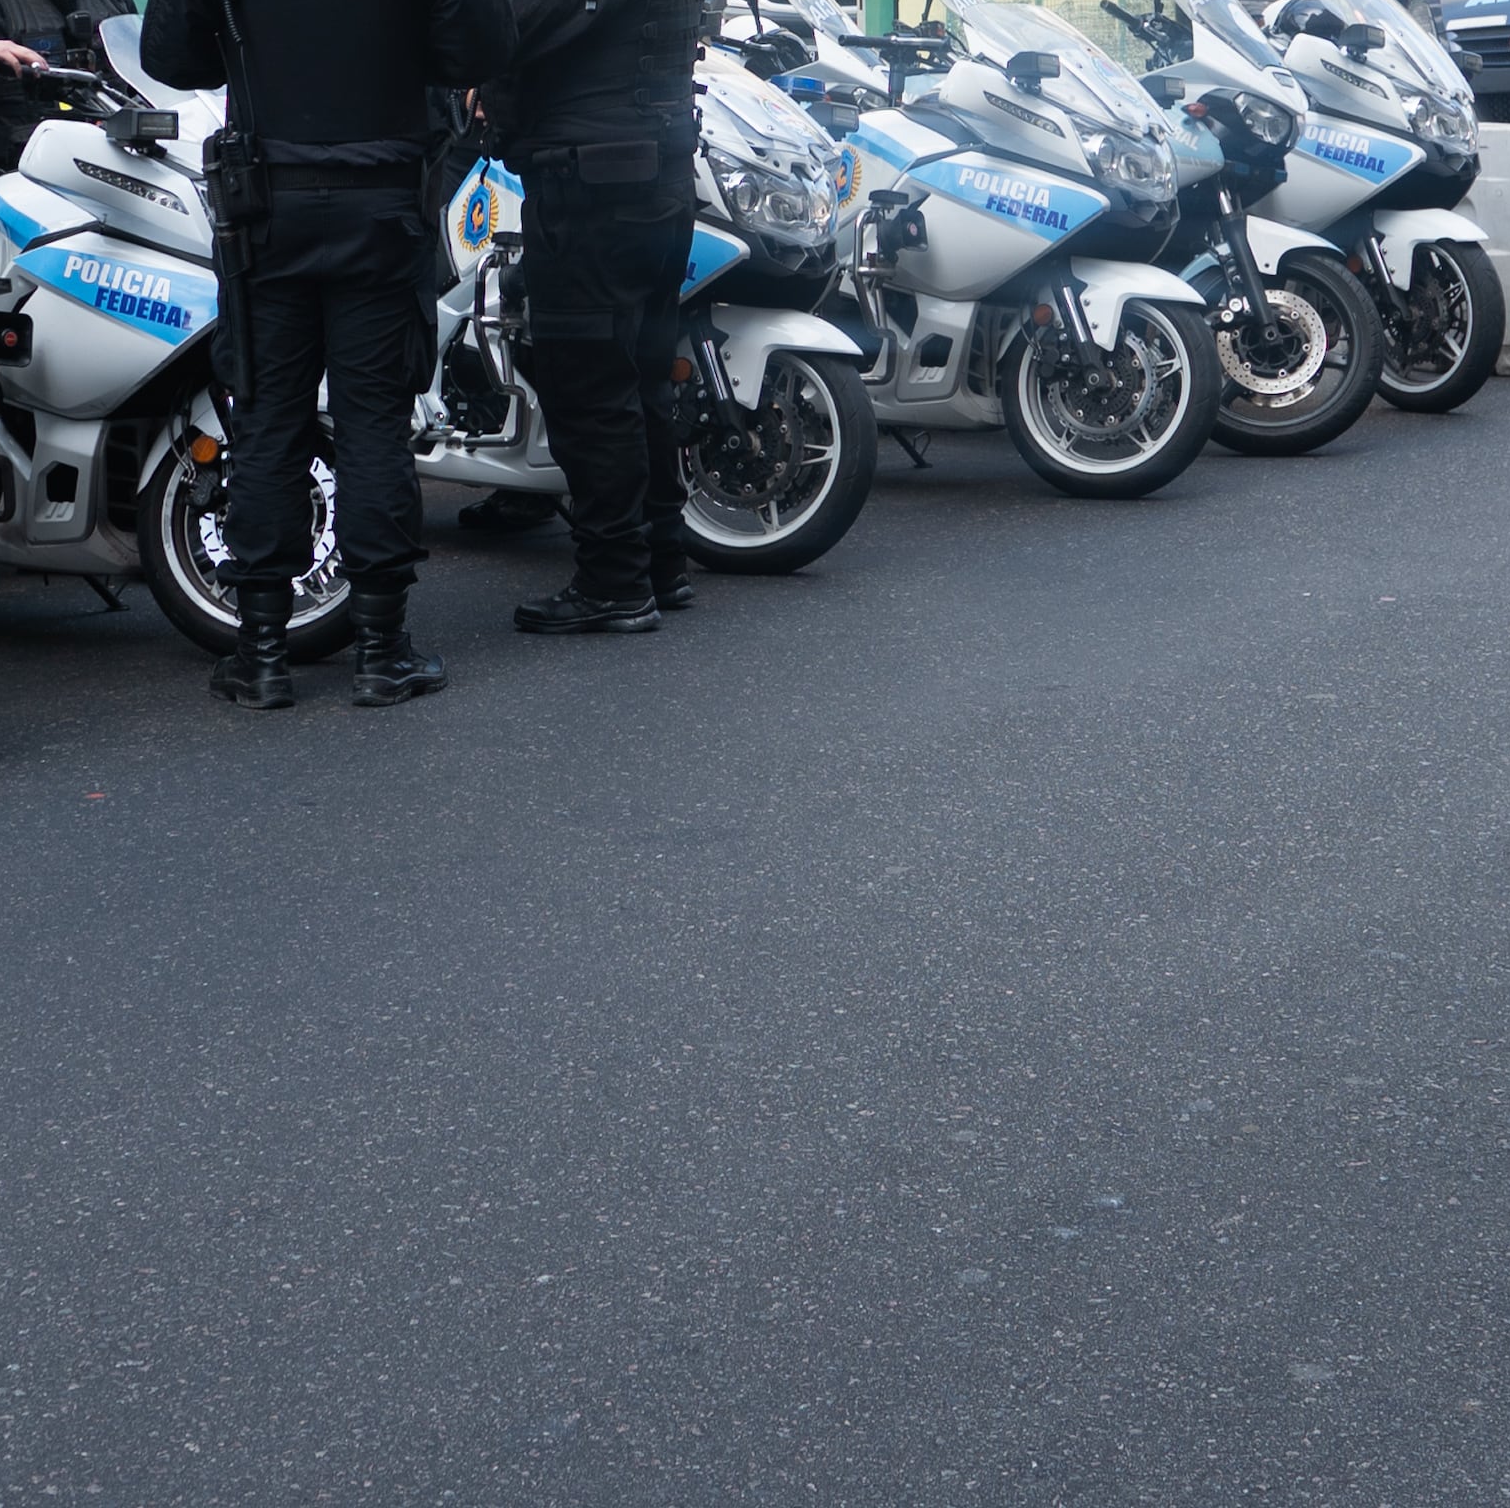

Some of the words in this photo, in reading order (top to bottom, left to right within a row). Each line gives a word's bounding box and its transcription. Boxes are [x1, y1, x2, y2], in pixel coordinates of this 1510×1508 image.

[1304, 124, 1370, 154] OLICIA
[1314, 142, 1386, 174] FEDERAL
[958, 167, 1051, 208] POLICIA
[985, 192, 1069, 232] FEDERAL
[63, 255, 171, 303] POLICIA
[94, 286, 194, 331] FEDERAL
